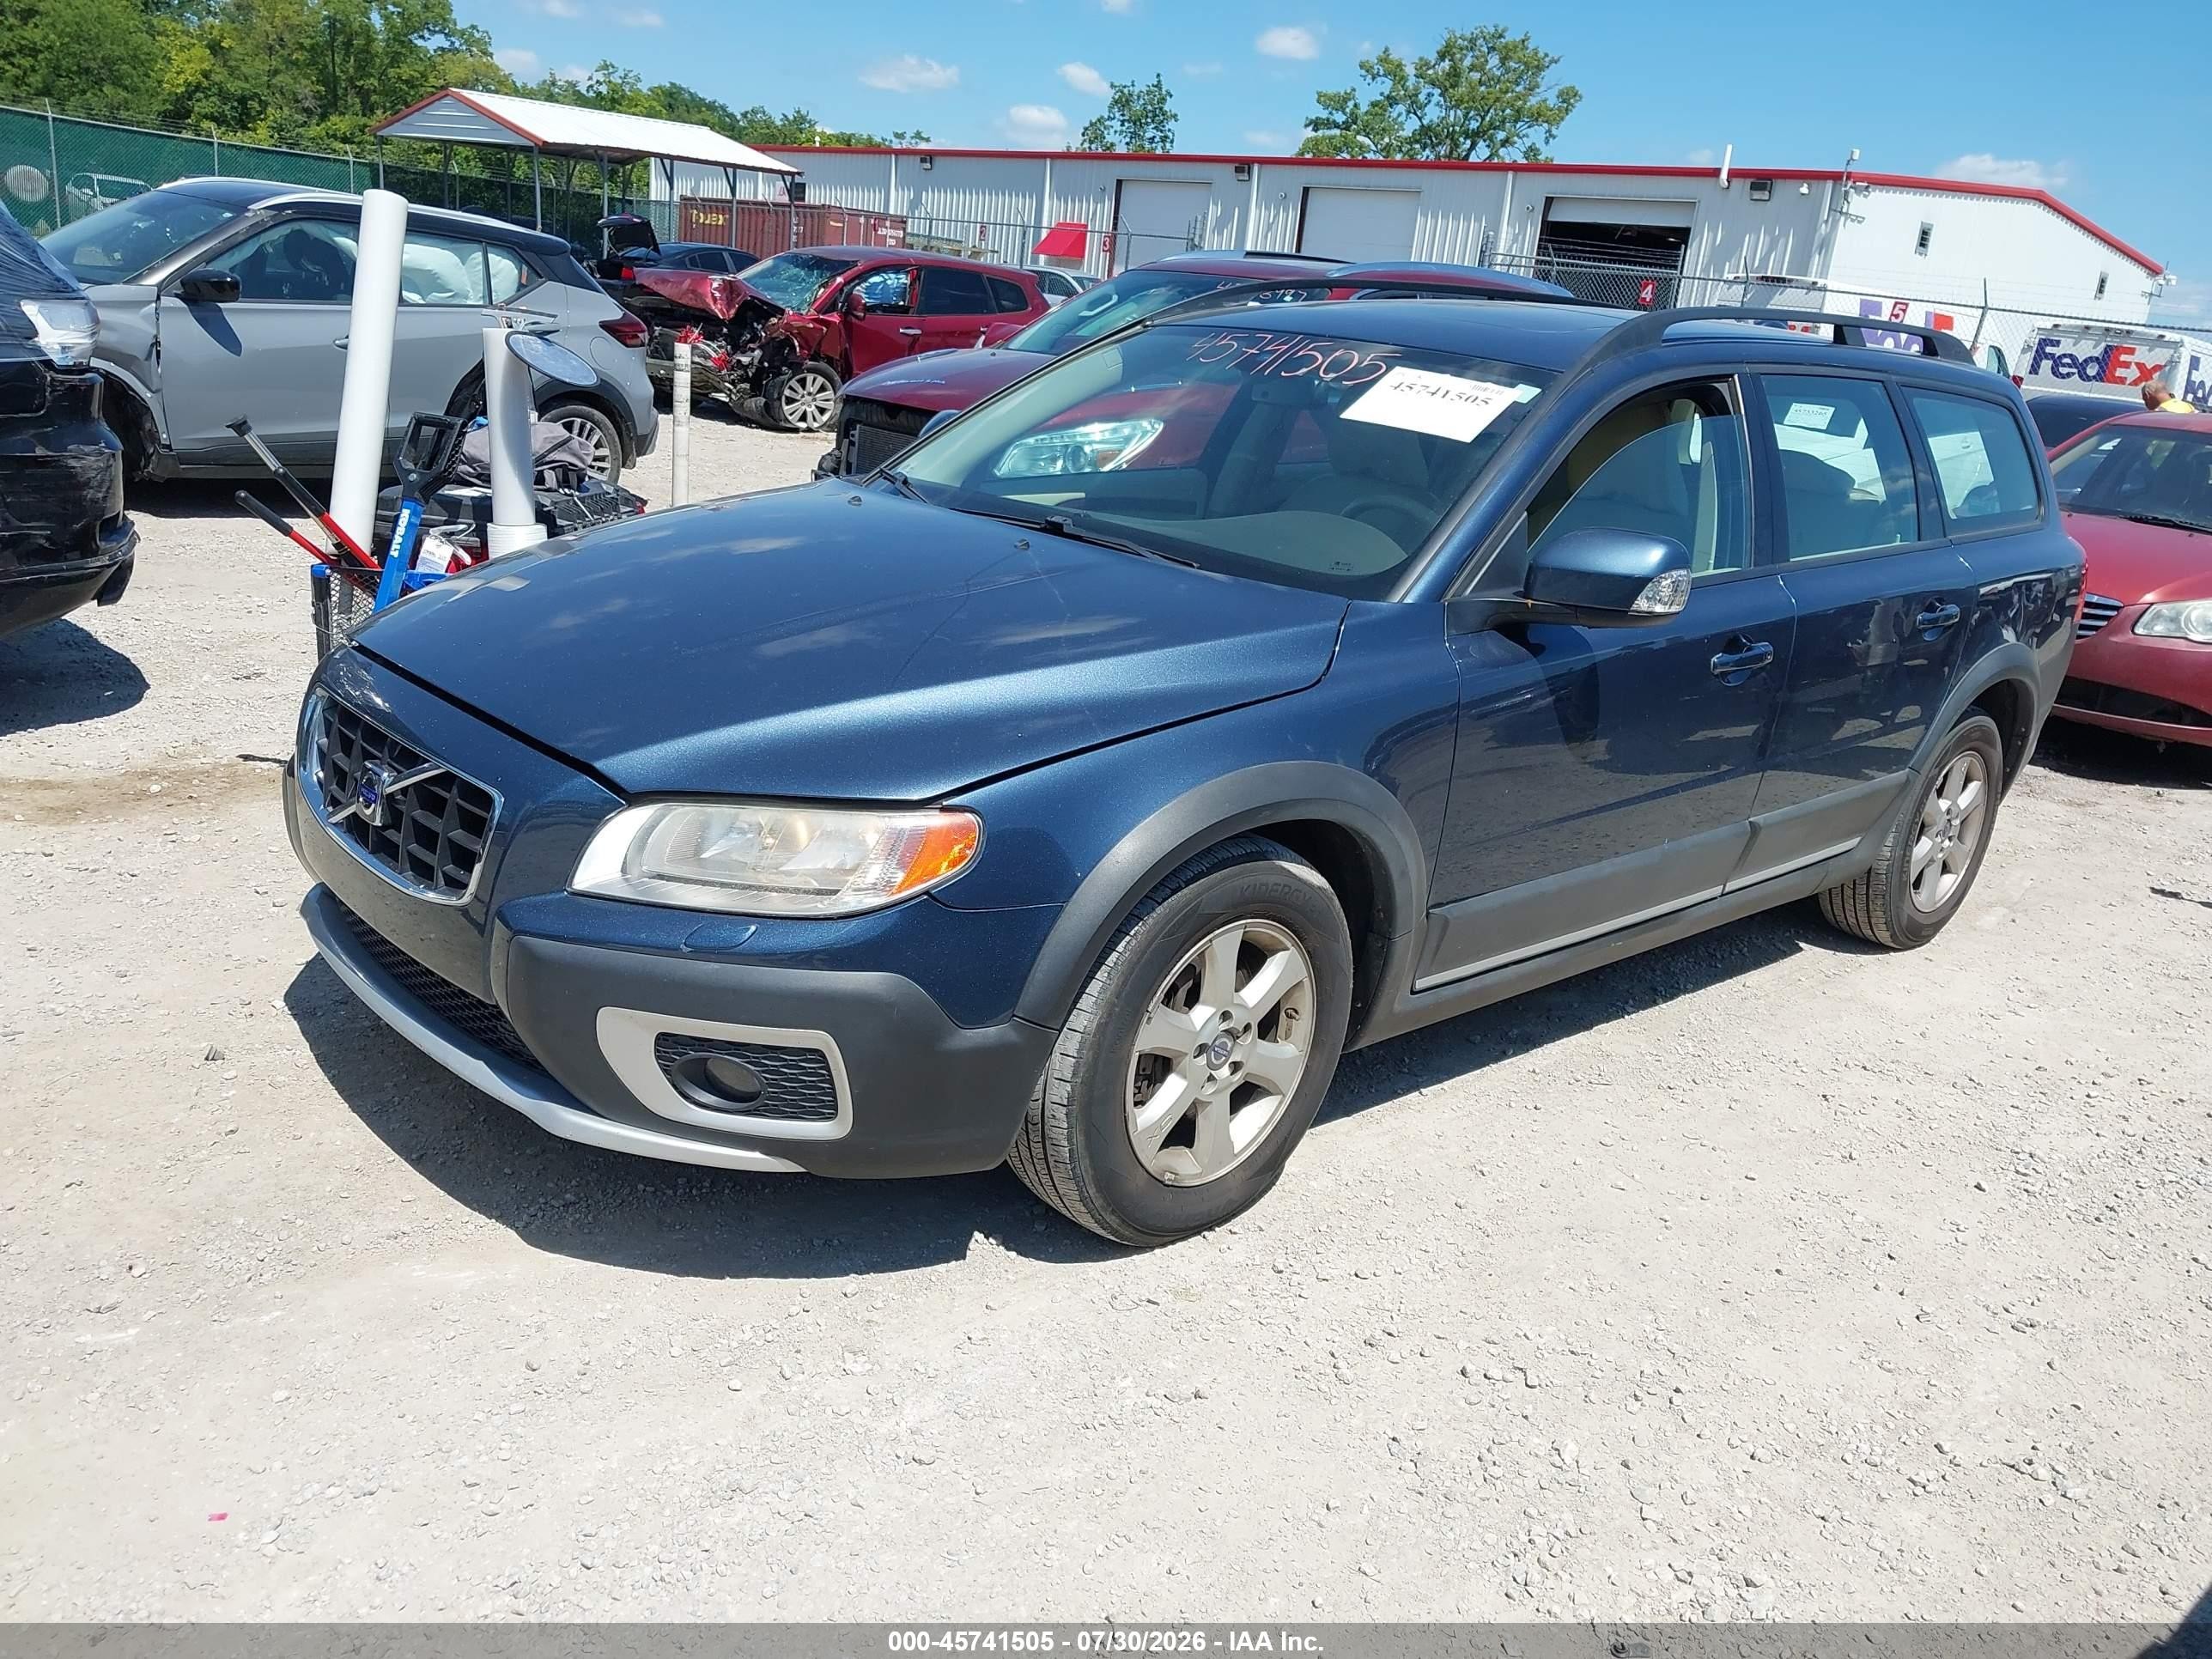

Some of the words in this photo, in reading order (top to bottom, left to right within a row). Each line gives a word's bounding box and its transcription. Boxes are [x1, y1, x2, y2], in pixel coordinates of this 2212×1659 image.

[980, 227, 987, 240] 2
[1103, 237, 1110, 251] 3
[1641, 283, 1654, 302] 4
[1890, 302, 1907, 324] 5
[1186, 331, 1402, 385] 45741505
[2028, 337, 2167, 387] FedEx
[1389, 381, 1493, 407] 45741505
[390, 508, 411, 558] KOBALT
